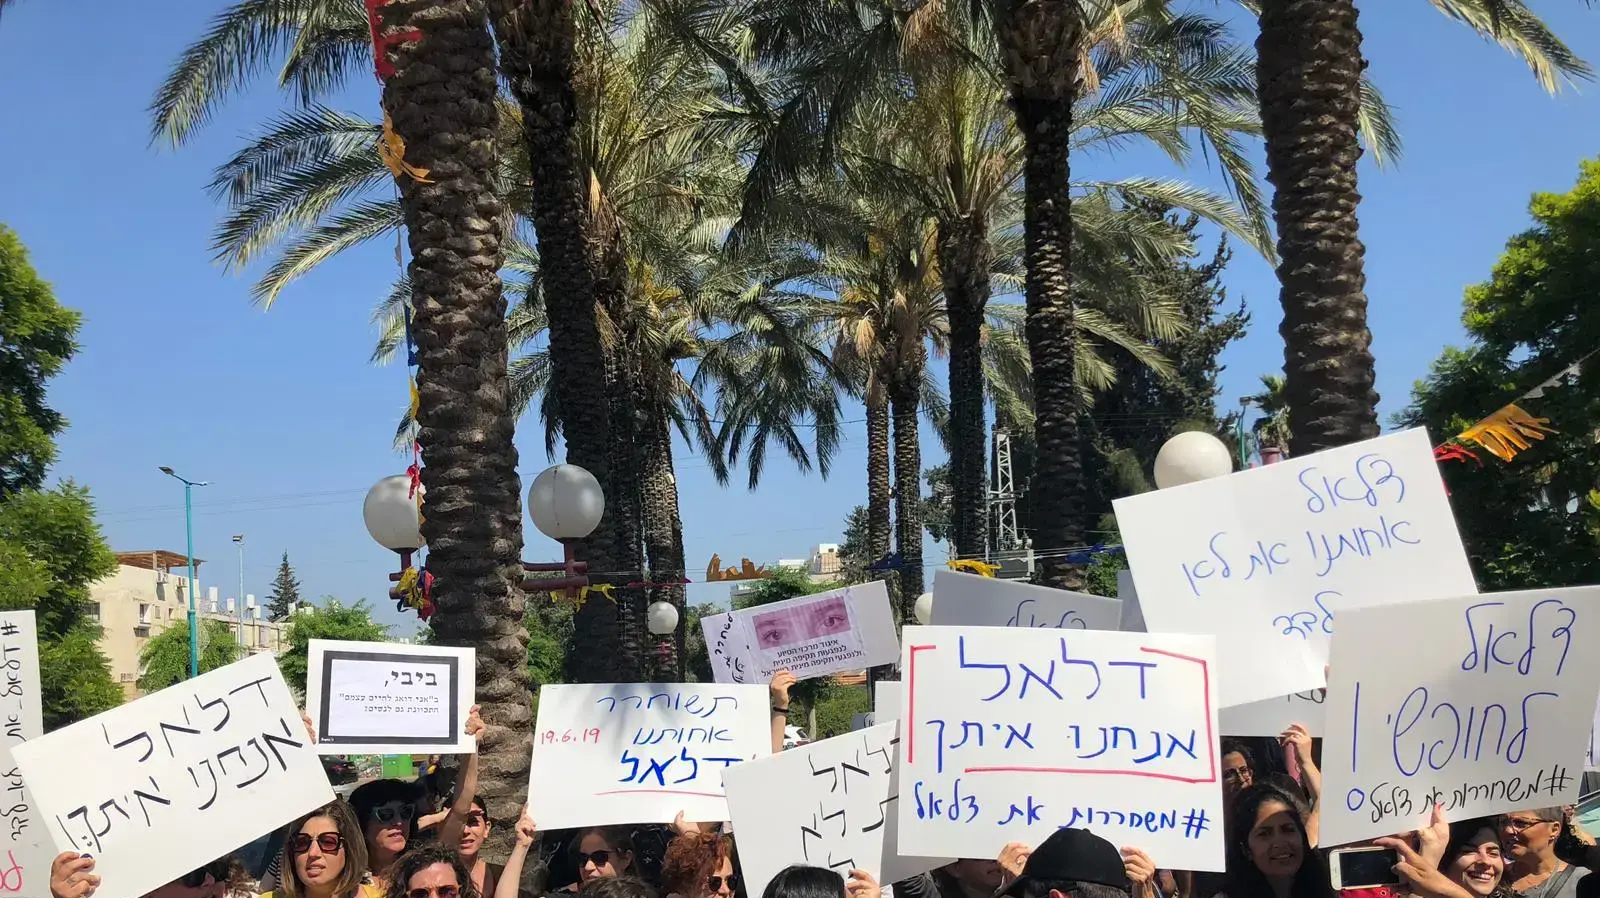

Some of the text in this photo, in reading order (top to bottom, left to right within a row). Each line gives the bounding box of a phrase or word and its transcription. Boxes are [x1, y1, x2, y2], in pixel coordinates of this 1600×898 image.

[1298, 452, 1406, 514] דלאל
[1305, 515, 1422, 577] אחותנו
[1243, 541, 1291, 582] את
[776, 639, 839, 658] איגוד מרכזי הסיוע
[1461, 600, 1577, 677] דלאל
[772, 644, 847, 667] לנפגעות תקיפה מינית
[790, 661, 811, 672] מינית
[810, 656, 835, 667] תקיפה
[835, 650, 863, 662] ולנפגעי
[958, 635, 1158, 702] דלאל
[384, 670, 438, 688] ביבי,
[368, 693, 392, 702] לחיים
[394, 705, 405, 713] גם
[395, 695, 413, 703] דואג
[596, 692, 738, 719] תשוחרר
[101, 676, 273, 763] דלאל
[540, 726, 602, 746] 19.6.19
[631, 726, 735, 747] אחותנו
[925, 719, 1199, 774] אנחנו איתך
[187, 717, 303, 811] אנחנו
[617, 746, 745, 788] דלאל
[808, 734, 900, 795] לאל
[912, 777, 1211, 839] #משחררות את דלאל
[1369, 781, 1413, 825] דלאל
[1419, 786, 1446, 815] את
